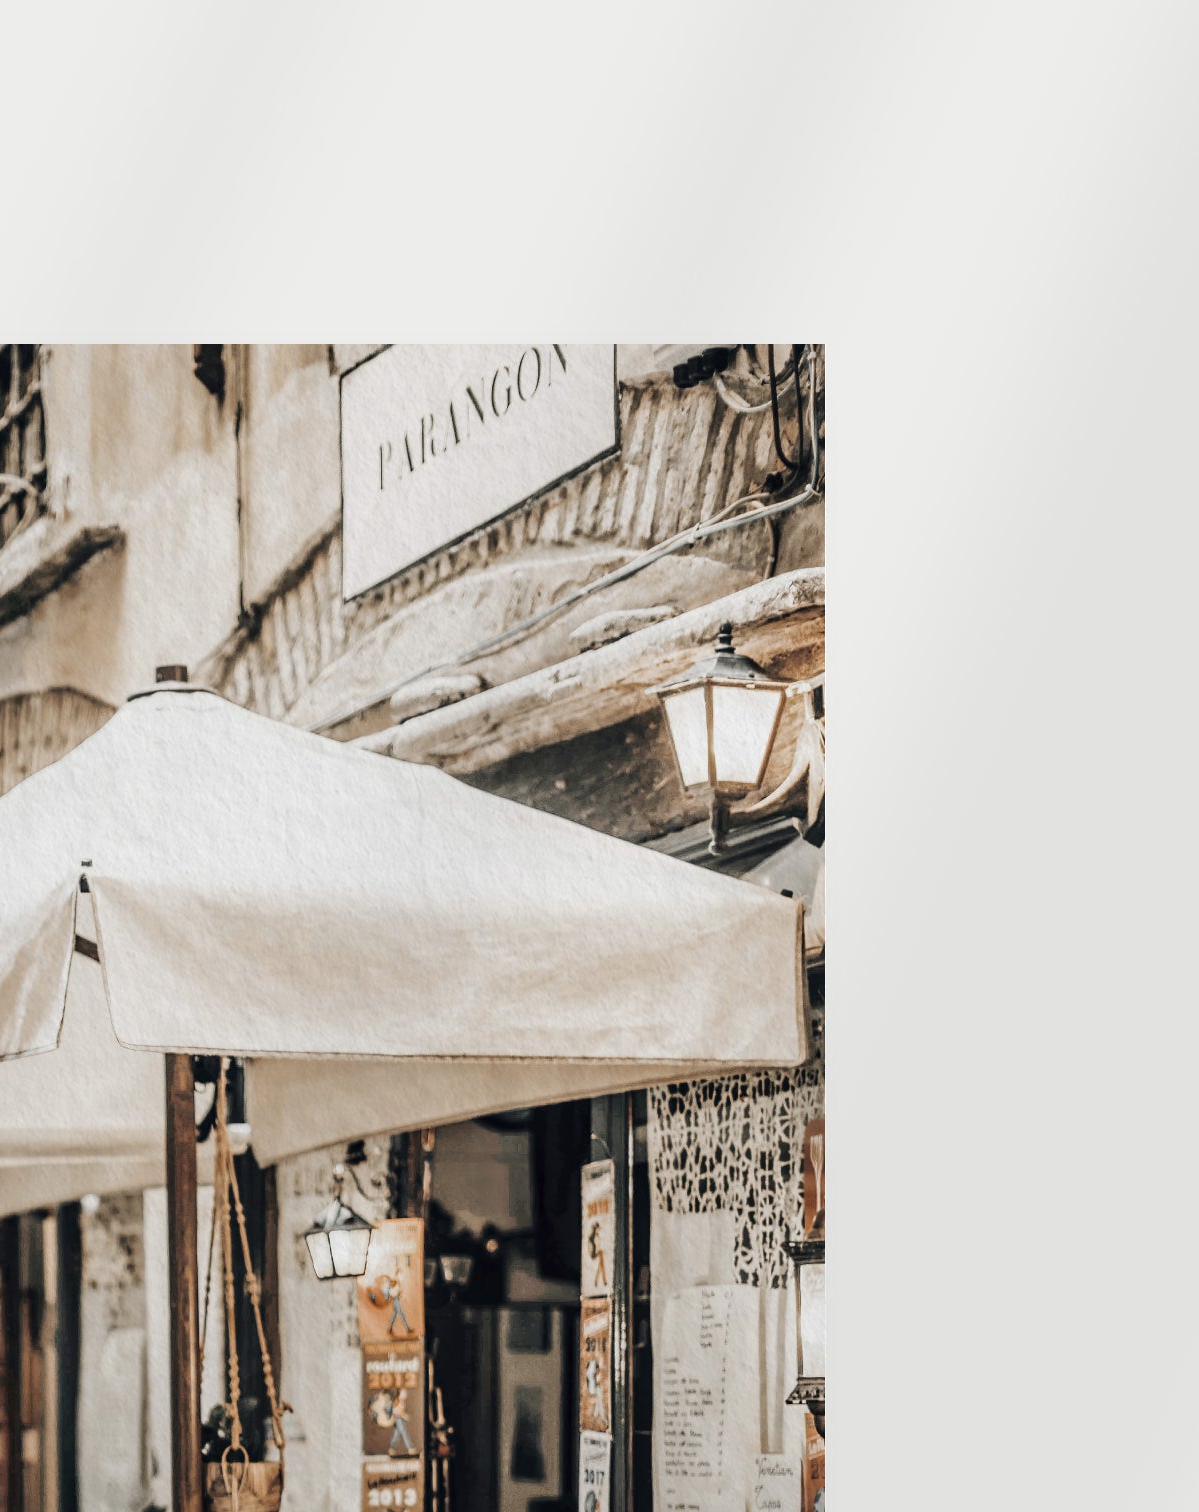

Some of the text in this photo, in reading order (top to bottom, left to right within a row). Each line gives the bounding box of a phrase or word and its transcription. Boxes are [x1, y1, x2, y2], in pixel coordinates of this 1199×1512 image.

[378, 343, 568, 491] PARANGON
[368, 1371, 418, 1390] 2012
[584, 1468, 605, 1486] 2017
[368, 1487, 418, 1507] 2013
